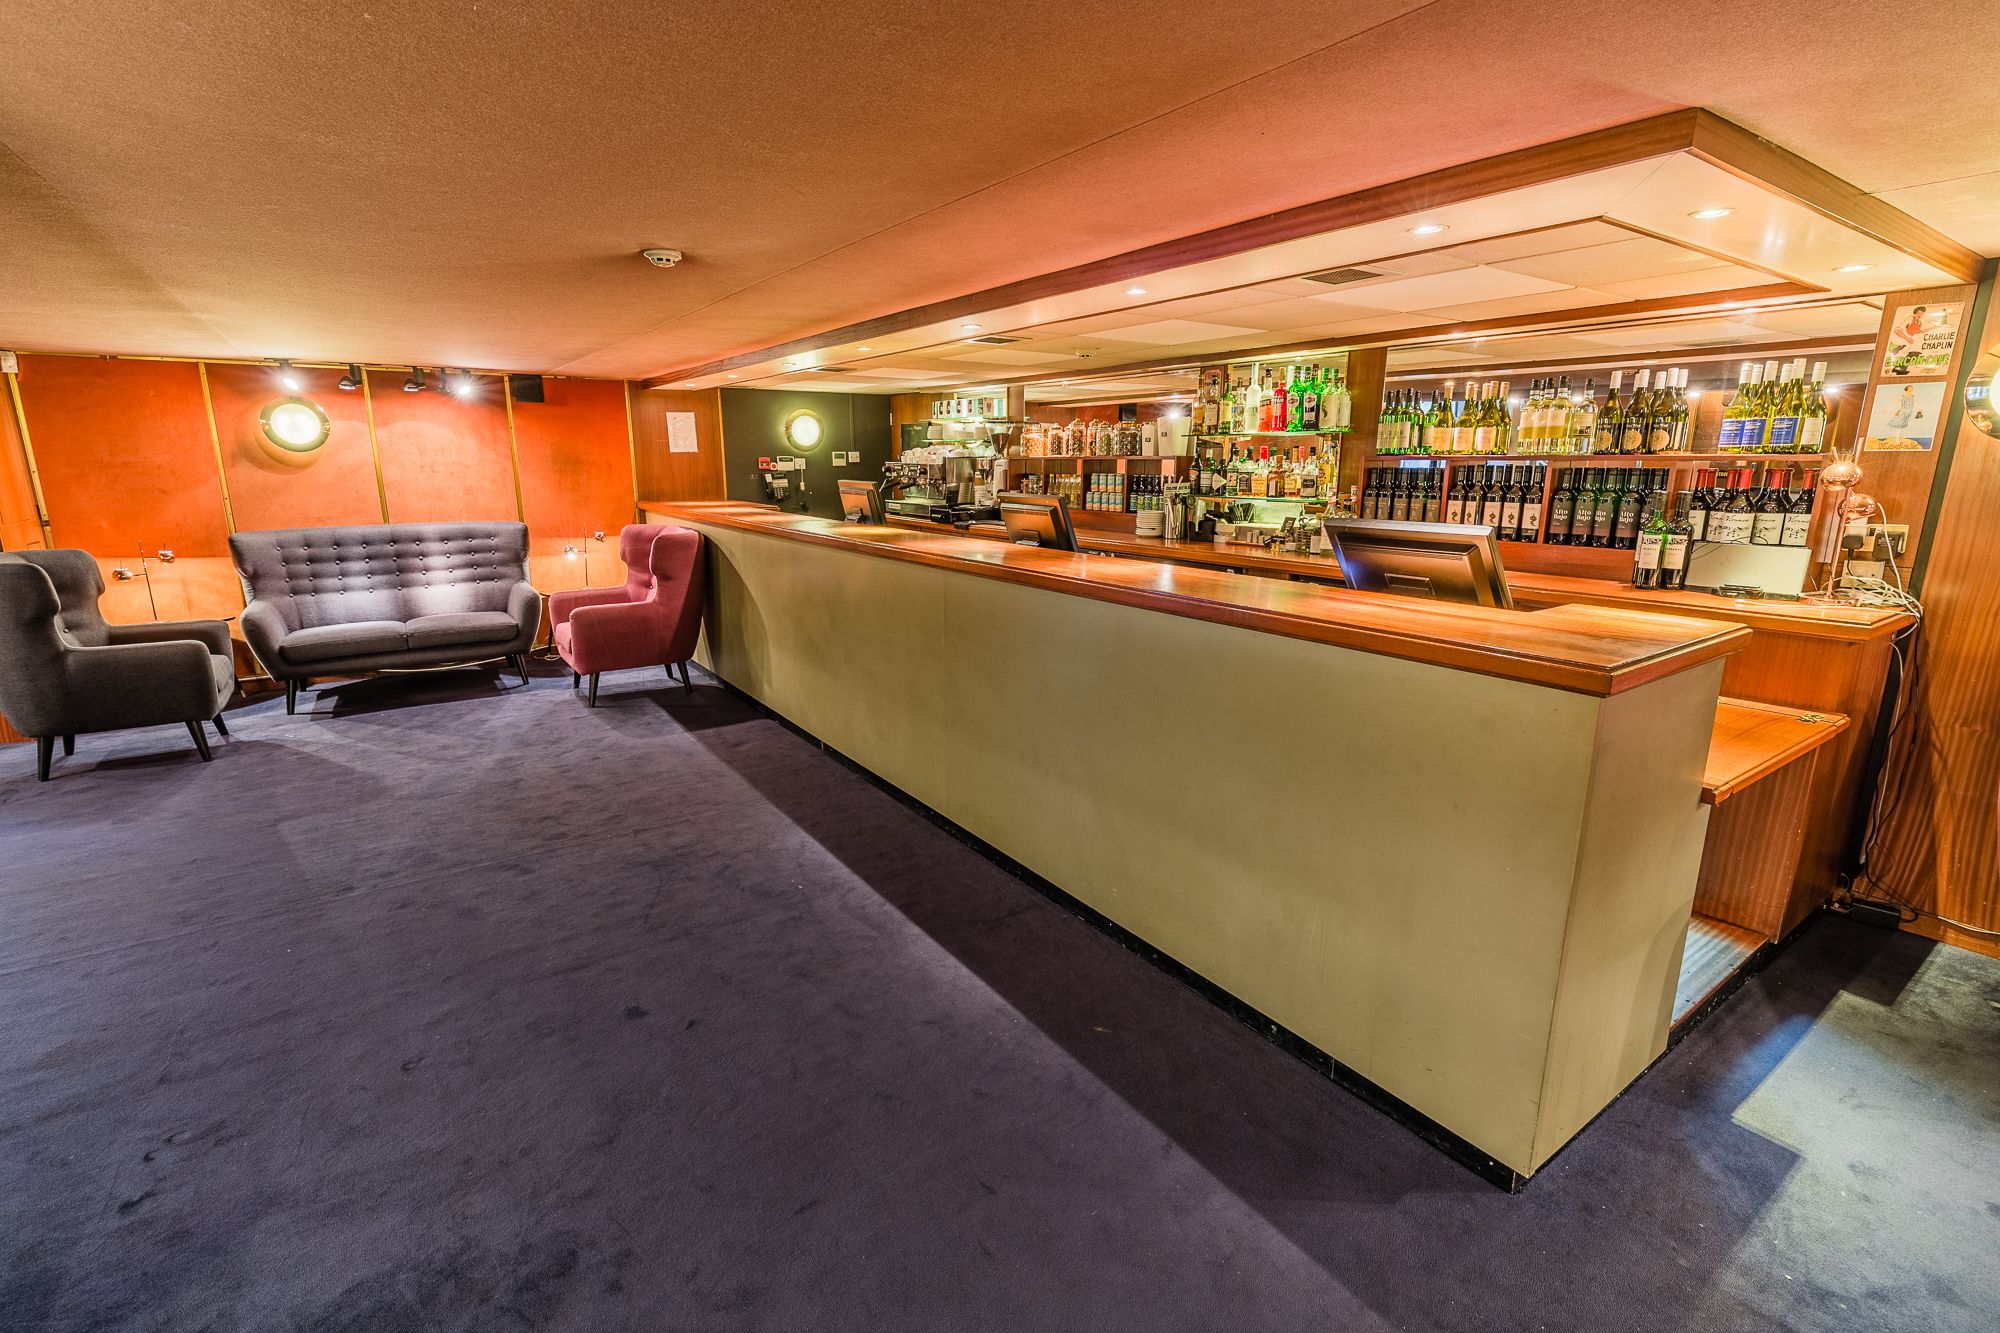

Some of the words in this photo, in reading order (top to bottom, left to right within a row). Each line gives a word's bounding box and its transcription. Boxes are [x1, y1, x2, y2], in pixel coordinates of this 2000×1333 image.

[1923, 332, 1955, 341] CHARLIE
[1921, 341, 1953, 350] CHAPLIN
[1877, 441, 1919, 450] Kodak
[1553, 513, 1568, 521] Bajo
